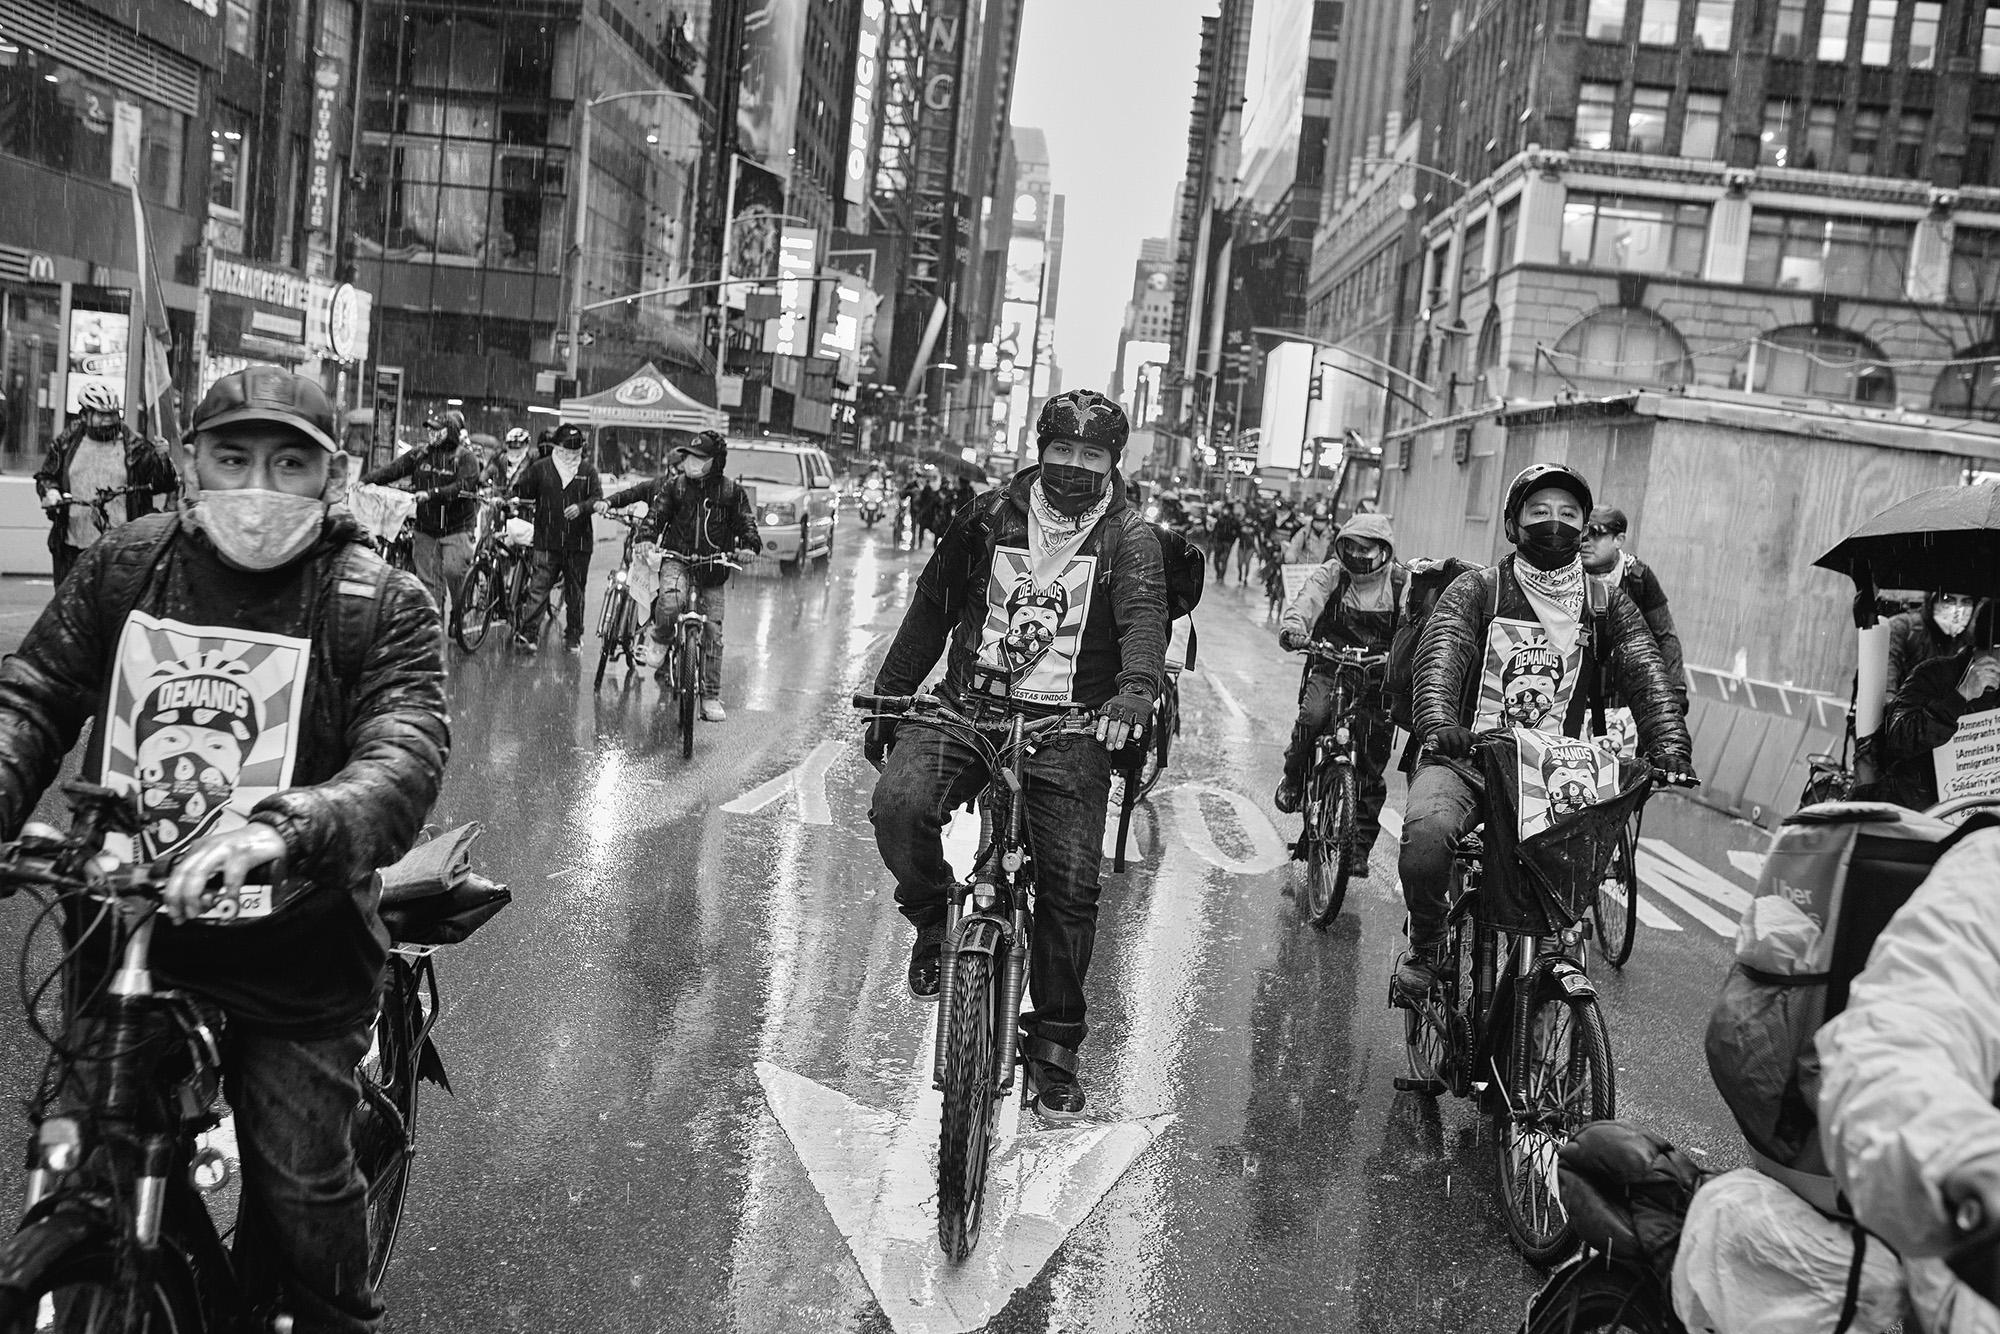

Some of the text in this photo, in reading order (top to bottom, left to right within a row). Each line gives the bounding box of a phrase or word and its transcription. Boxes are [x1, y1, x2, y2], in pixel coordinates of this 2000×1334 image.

[848, 30, 877, 180] OFFICE
[310, 88, 335, 227] MIDTOWN COMICS
[1514, 650, 1559, 670] DEMANDS
[157, 678, 249, 718] DEMANDS
[1040, 693, 1069, 702] UNIDOS
[1959, 718, 1993, 731] Amnesty
[1951, 779, 1989, 793] Solidarity
